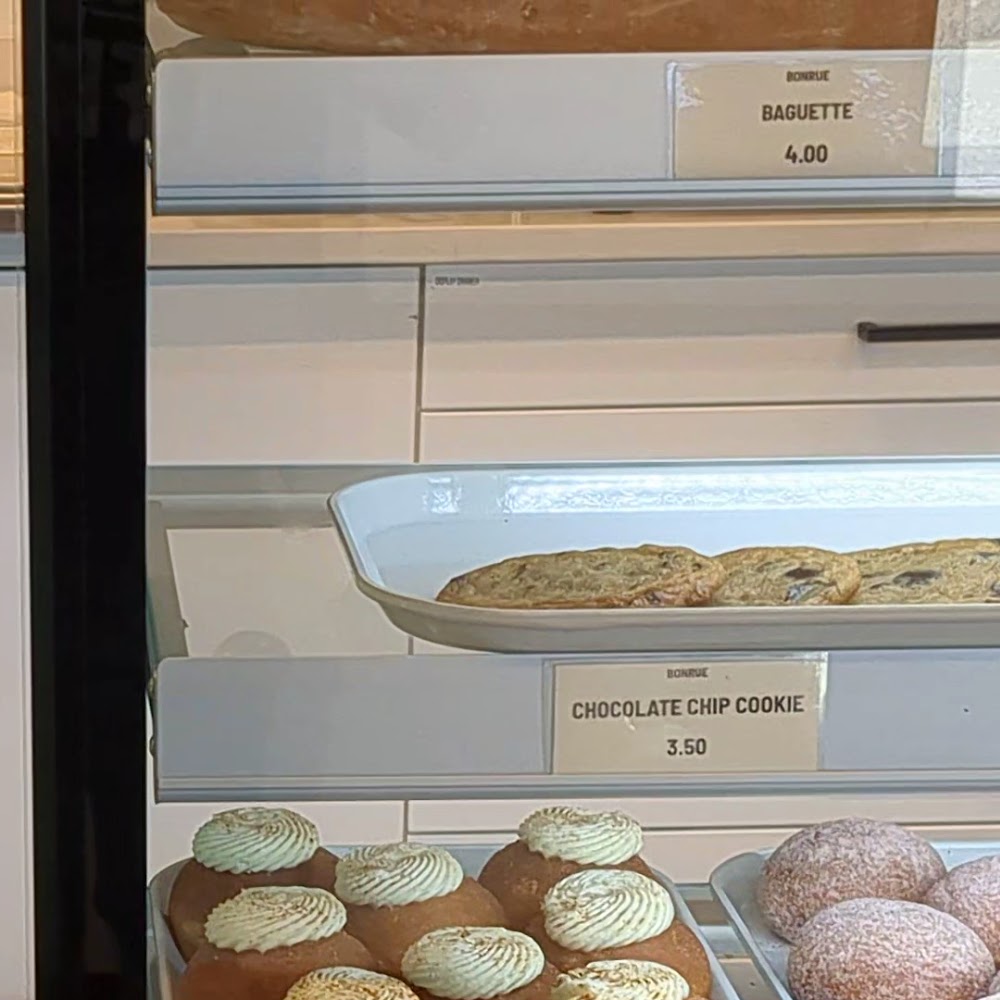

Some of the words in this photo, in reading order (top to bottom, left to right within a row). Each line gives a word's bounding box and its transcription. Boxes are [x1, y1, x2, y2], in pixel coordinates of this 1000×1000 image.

[786, 70, 829, 82] BONRUE
[761, 103, 854, 121] BAGUETTE
[784, 144, 829, 163] 4.00
[667, 667, 709, 678] BONRUE
[572, 699, 683, 719] CHOCOLATE
[687, 697, 731, 715] CHIP
[735, 695, 805, 714] COOKIE
[666, 738, 707, 756] 3.50
